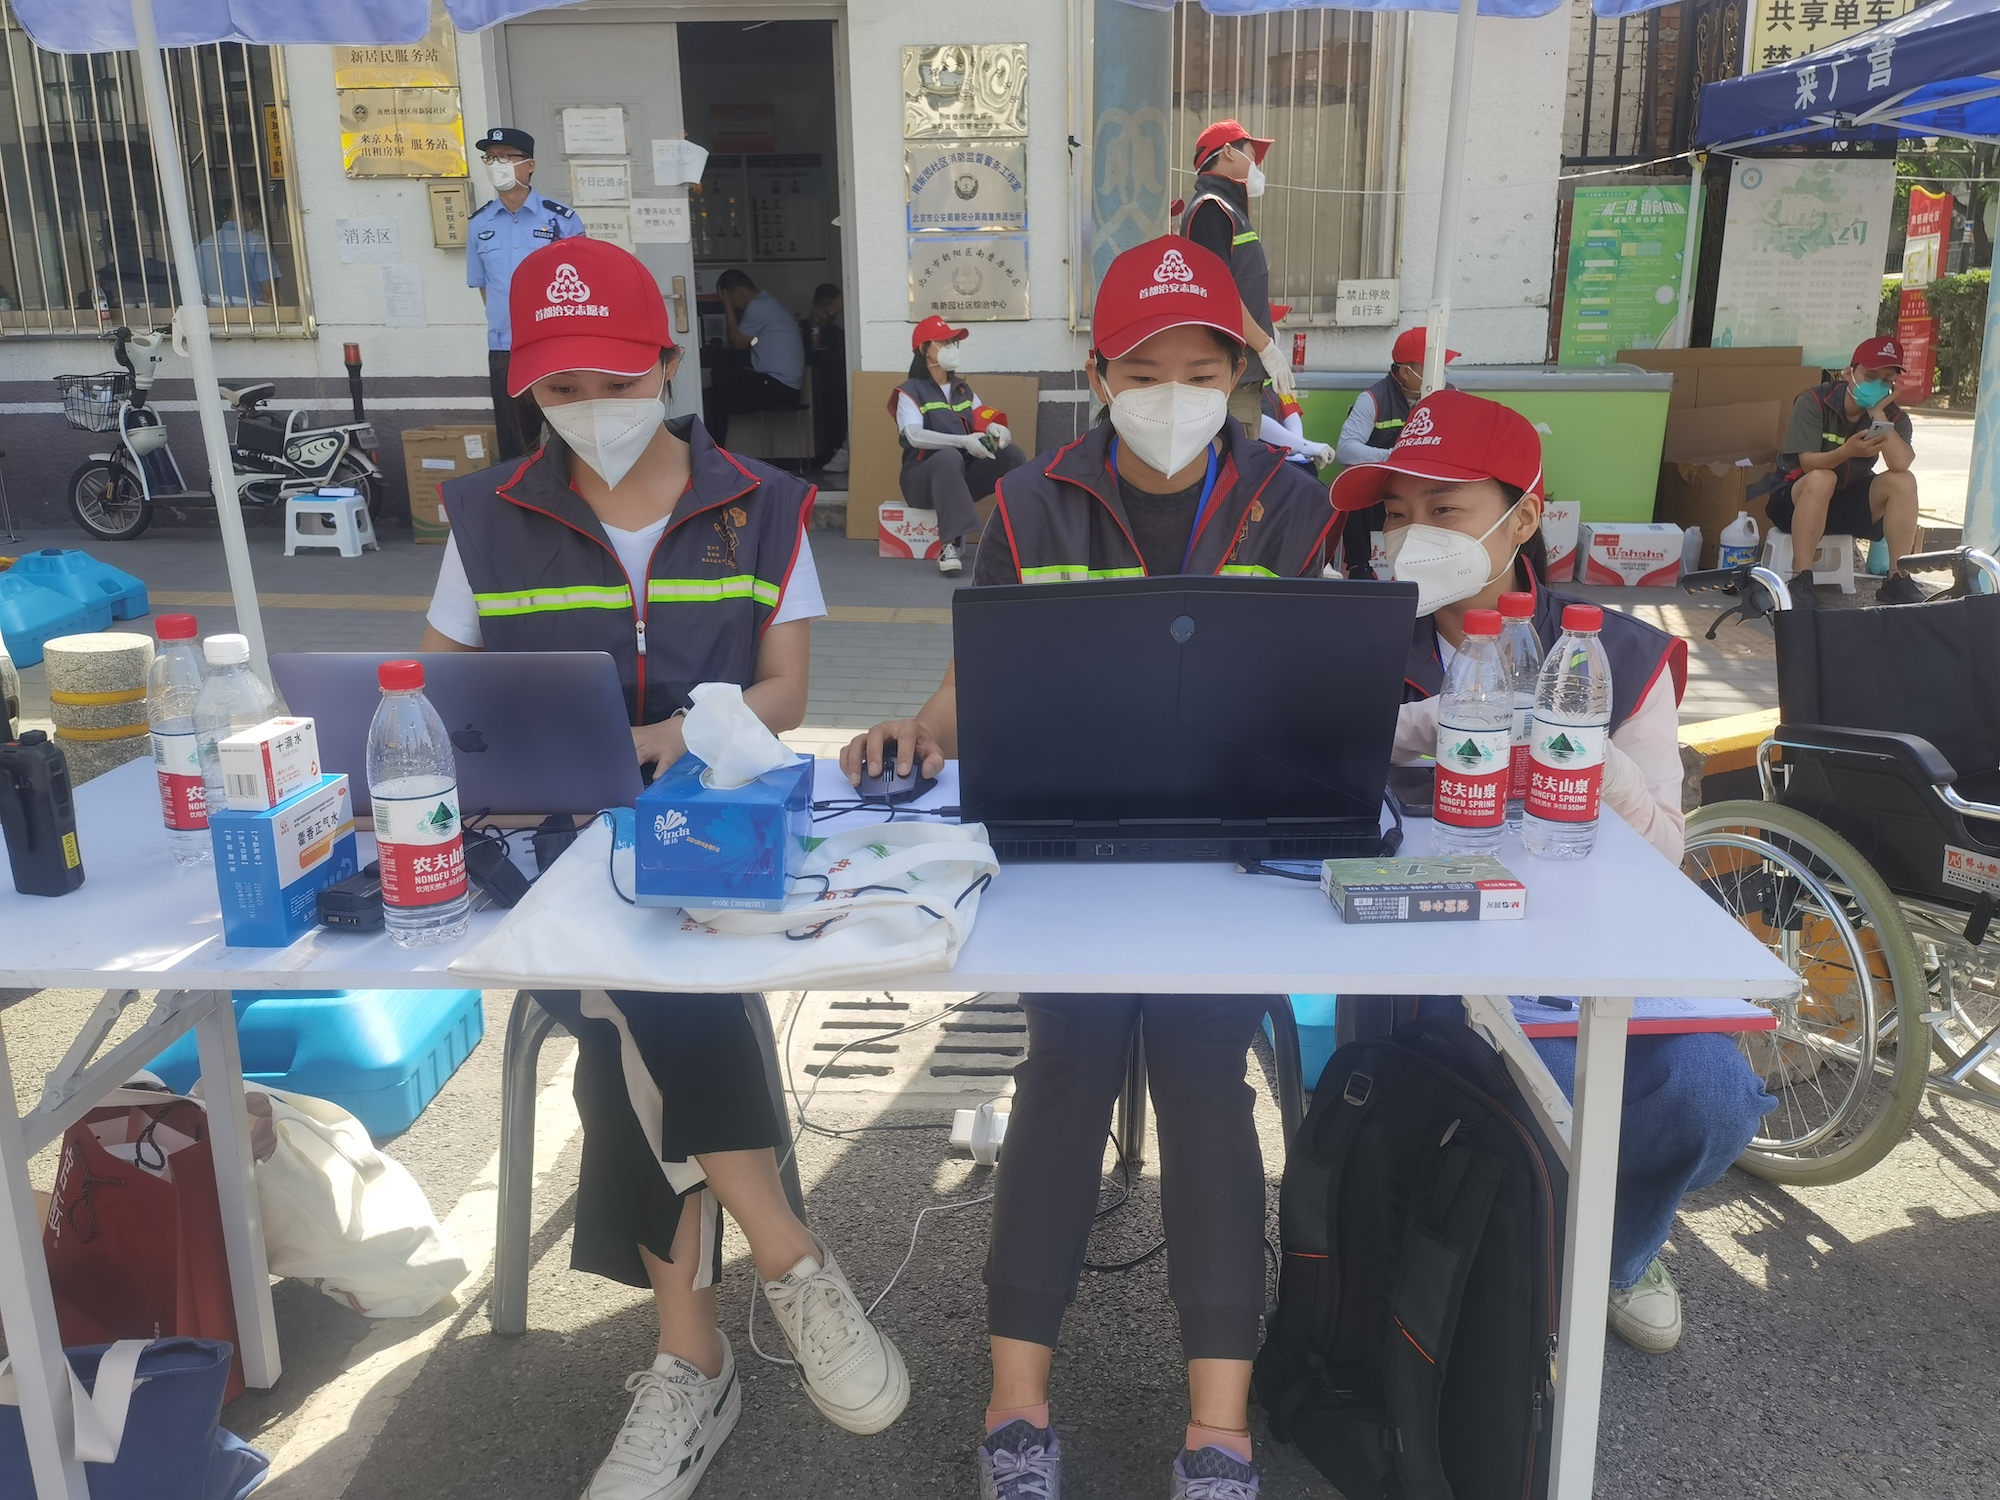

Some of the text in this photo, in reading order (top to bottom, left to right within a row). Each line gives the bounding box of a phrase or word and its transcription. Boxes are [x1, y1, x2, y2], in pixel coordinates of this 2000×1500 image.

[1766, 0, 1893, 31] 共享单车
[350, 48, 438, 64] 新居民服务站
[1794, 38, 1897, 110] 来广营
[361, 134, 403, 144] 来京人员
[411, 138, 448, 151] 服务站
[361, 147, 405, 157] 出租房屋
[578, 176, 626, 188] 今日已消杀
[444, 196, 458, 240] 警民联系箱
[344, 228, 392, 244] 消杀区
[1139, 283, 1208, 299] 首都治安志愿者
[1346, 289, 1390, 301] 禁止停放
[535, 304, 610, 322] 首都治安志愿者
[1352, 305, 1384, 316] 自行车
[1606, 547, 1664, 560] Wahaha
[276, 732, 302, 752] 十滴水
[1440, 779, 1496, 799] 农夫山泉
[1531, 772, 1588, 794] 农夫山泉
[1440, 795, 1496, 808] NONGFU SPRING
[1531, 787, 1587, 803] NONGFU SPRING
[188, 801, 206, 810] NON
[297, 811, 339, 847] 藿香正气水
[654, 826, 690, 841] Vinda
[414, 870, 450, 884] NONGFU
[1419, 899, 1470, 913] 创意中性
[674, 1360, 699, 1379] Reebok
[684, 1418, 703, 1448] Reebk
